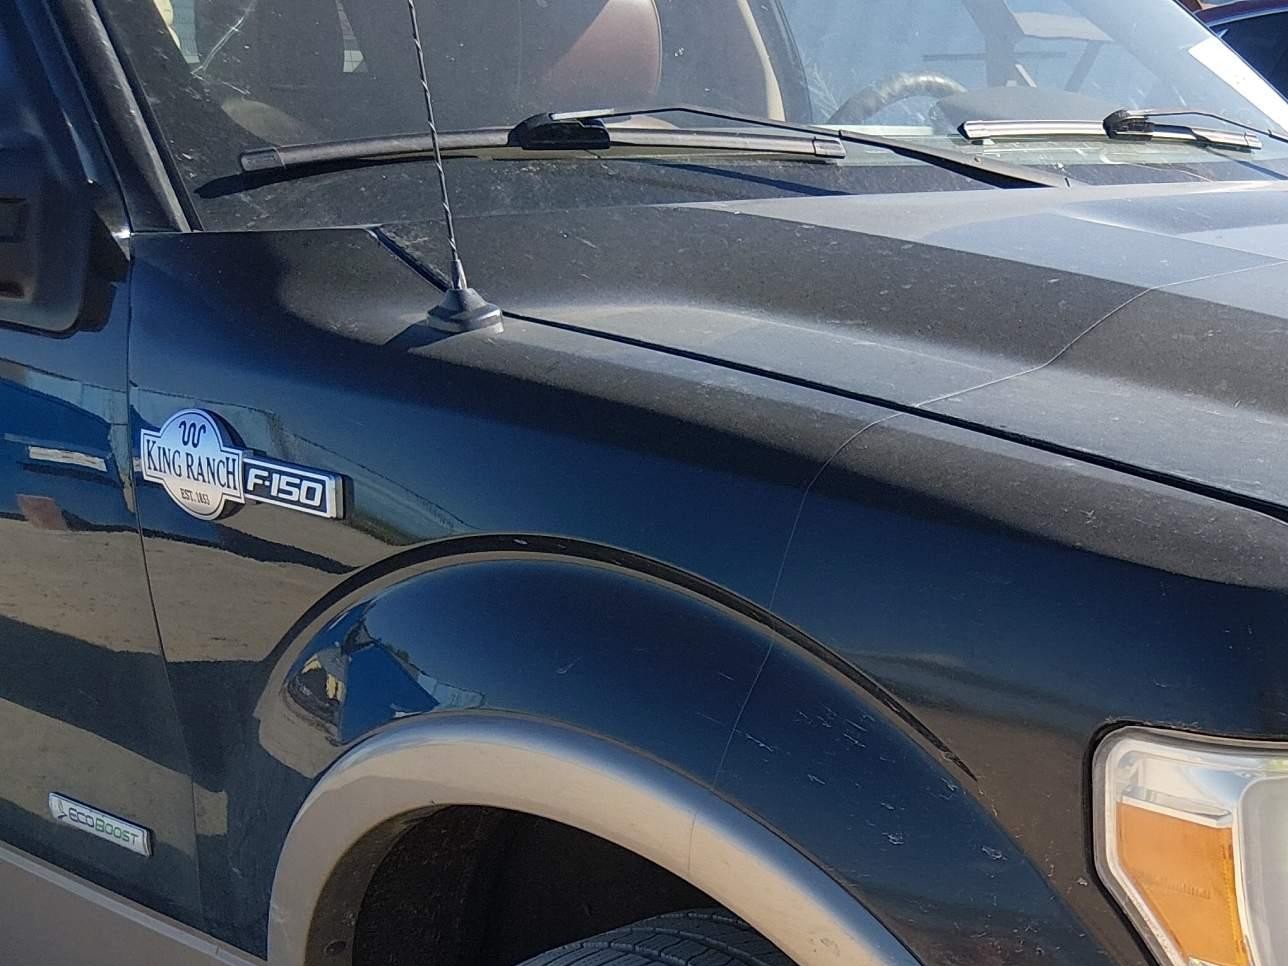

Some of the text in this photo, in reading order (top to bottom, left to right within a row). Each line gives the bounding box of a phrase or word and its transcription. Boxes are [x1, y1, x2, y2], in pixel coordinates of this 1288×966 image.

[146, 440, 238, 490] KING RANCH
[247, 468, 323, 507] F-150
